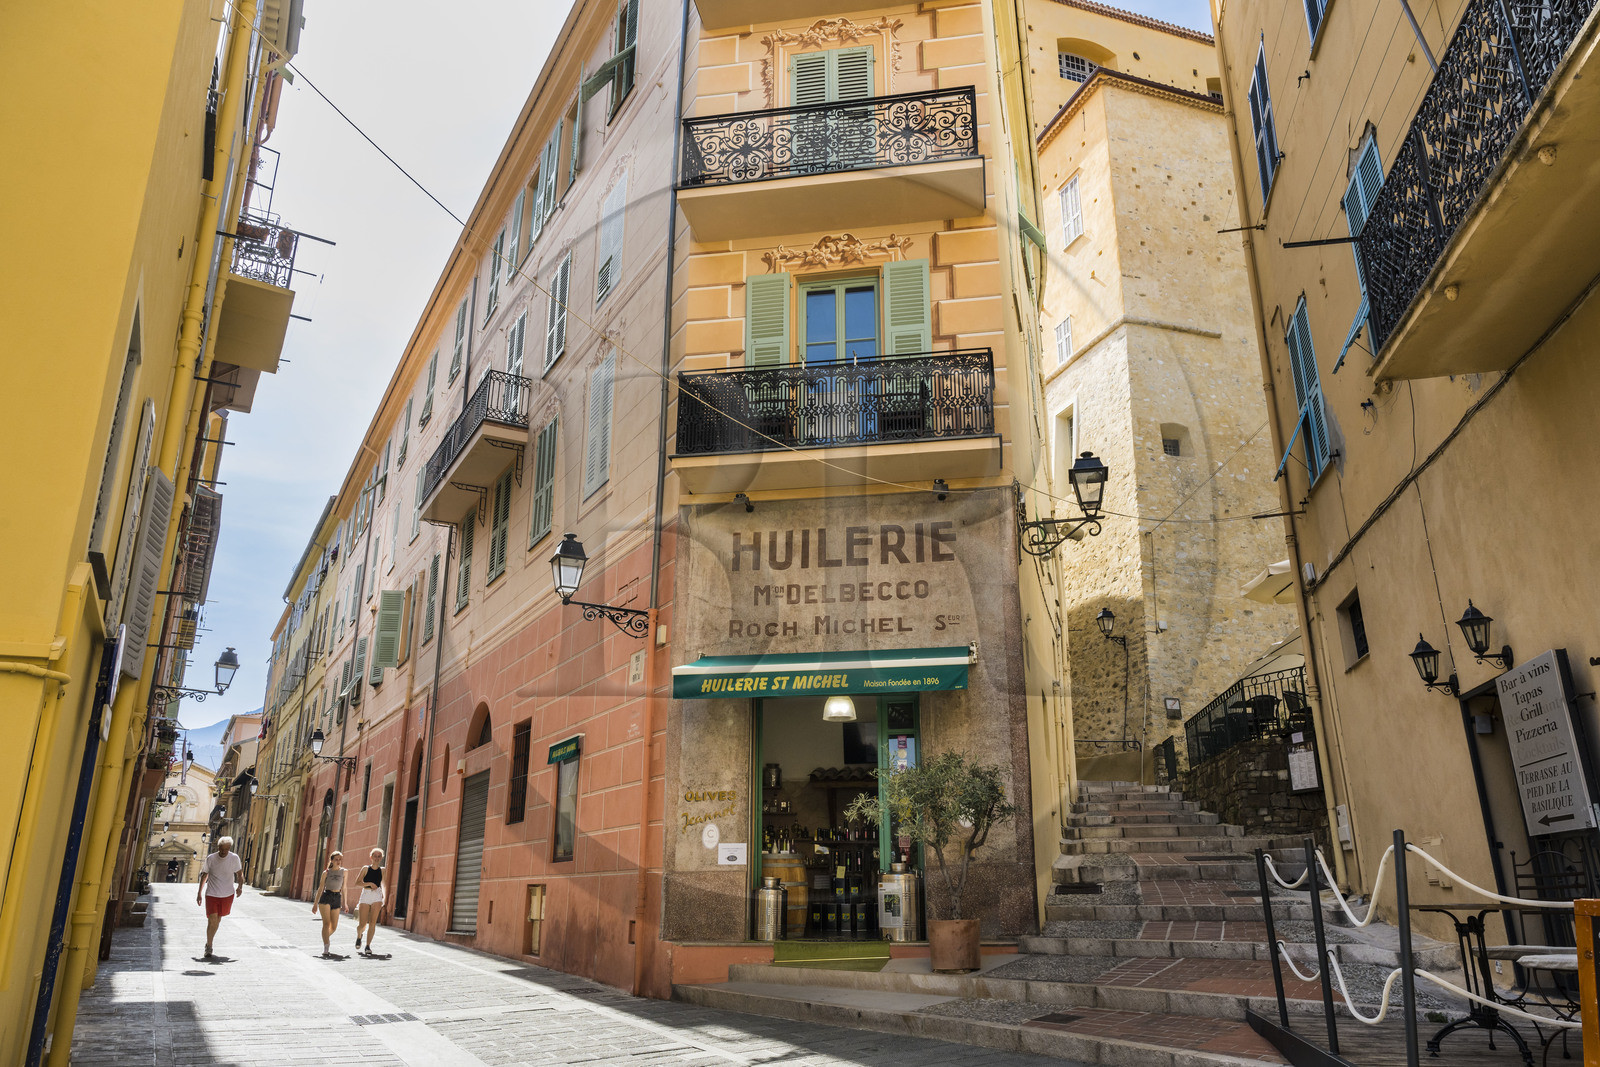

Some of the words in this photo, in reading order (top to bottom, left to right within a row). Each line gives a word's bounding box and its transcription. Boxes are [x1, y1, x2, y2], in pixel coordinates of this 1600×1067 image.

[731, 520, 957, 572] HUILERIE
[786, 579, 929, 605] DELBECCO
[728, 619, 798, 639] ROCH
[814, 615, 913, 636] MICHEL
[701, 677, 769, 693] HUILERIE
[771, 676, 790, 690] ST
[792, 674, 849, 690] MICHEL
[863, 680, 887, 688] Maison
[922, 677, 940, 686] 1896
[1500, 677, 1518, 694] Bar
[1519, 671, 1527, 684] à
[1527, 662, 1550, 680] vins
[1512, 685, 1543, 706] Tapas
[1520, 701, 1544, 722] Grill
[1515, 718, 1558, 744] Pizzeria
[1519, 765, 1559, 786] TERRASSE
[1560, 761, 1573, 776] AU
[685, 791, 736, 802] OLIVES
[1526, 785, 1544, 800] PIED
[1545, 781, 1557, 795] DE
[1558, 778, 1570, 792] LA
[1531, 794, 1574, 814] BASILIQUE
[681, 802, 736, 834] Jeannot
